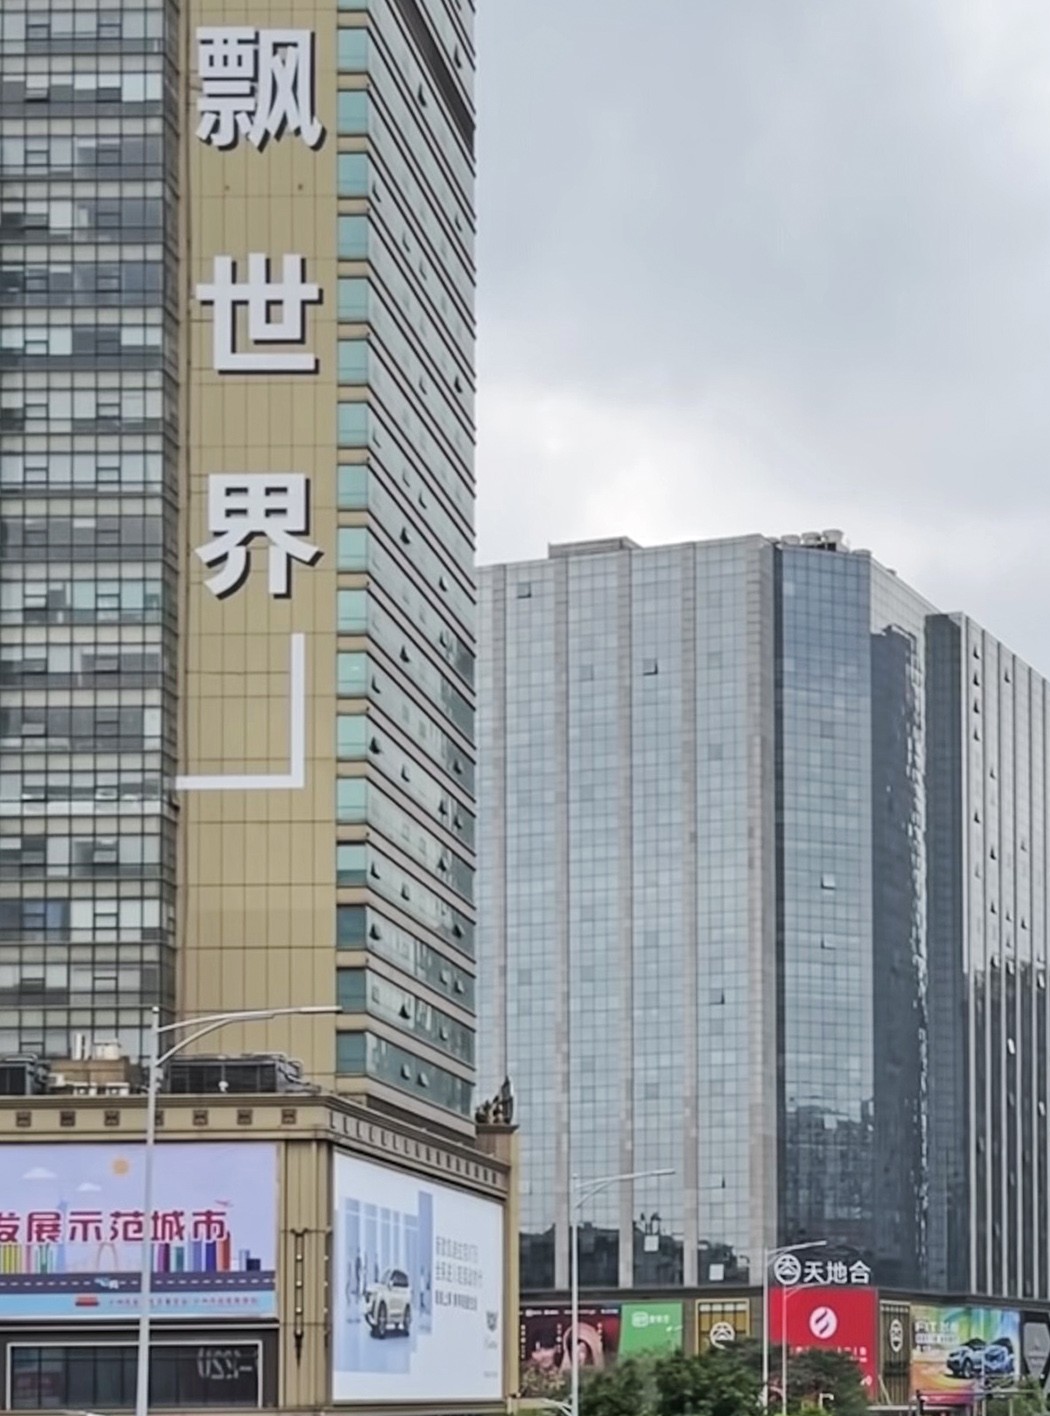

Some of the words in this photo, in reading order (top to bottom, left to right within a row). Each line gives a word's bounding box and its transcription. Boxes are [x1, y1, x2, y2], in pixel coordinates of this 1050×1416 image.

[0, 1210, 228, 1242] 发展示范城市
[803, 1260, 872, 1285] 天地合
